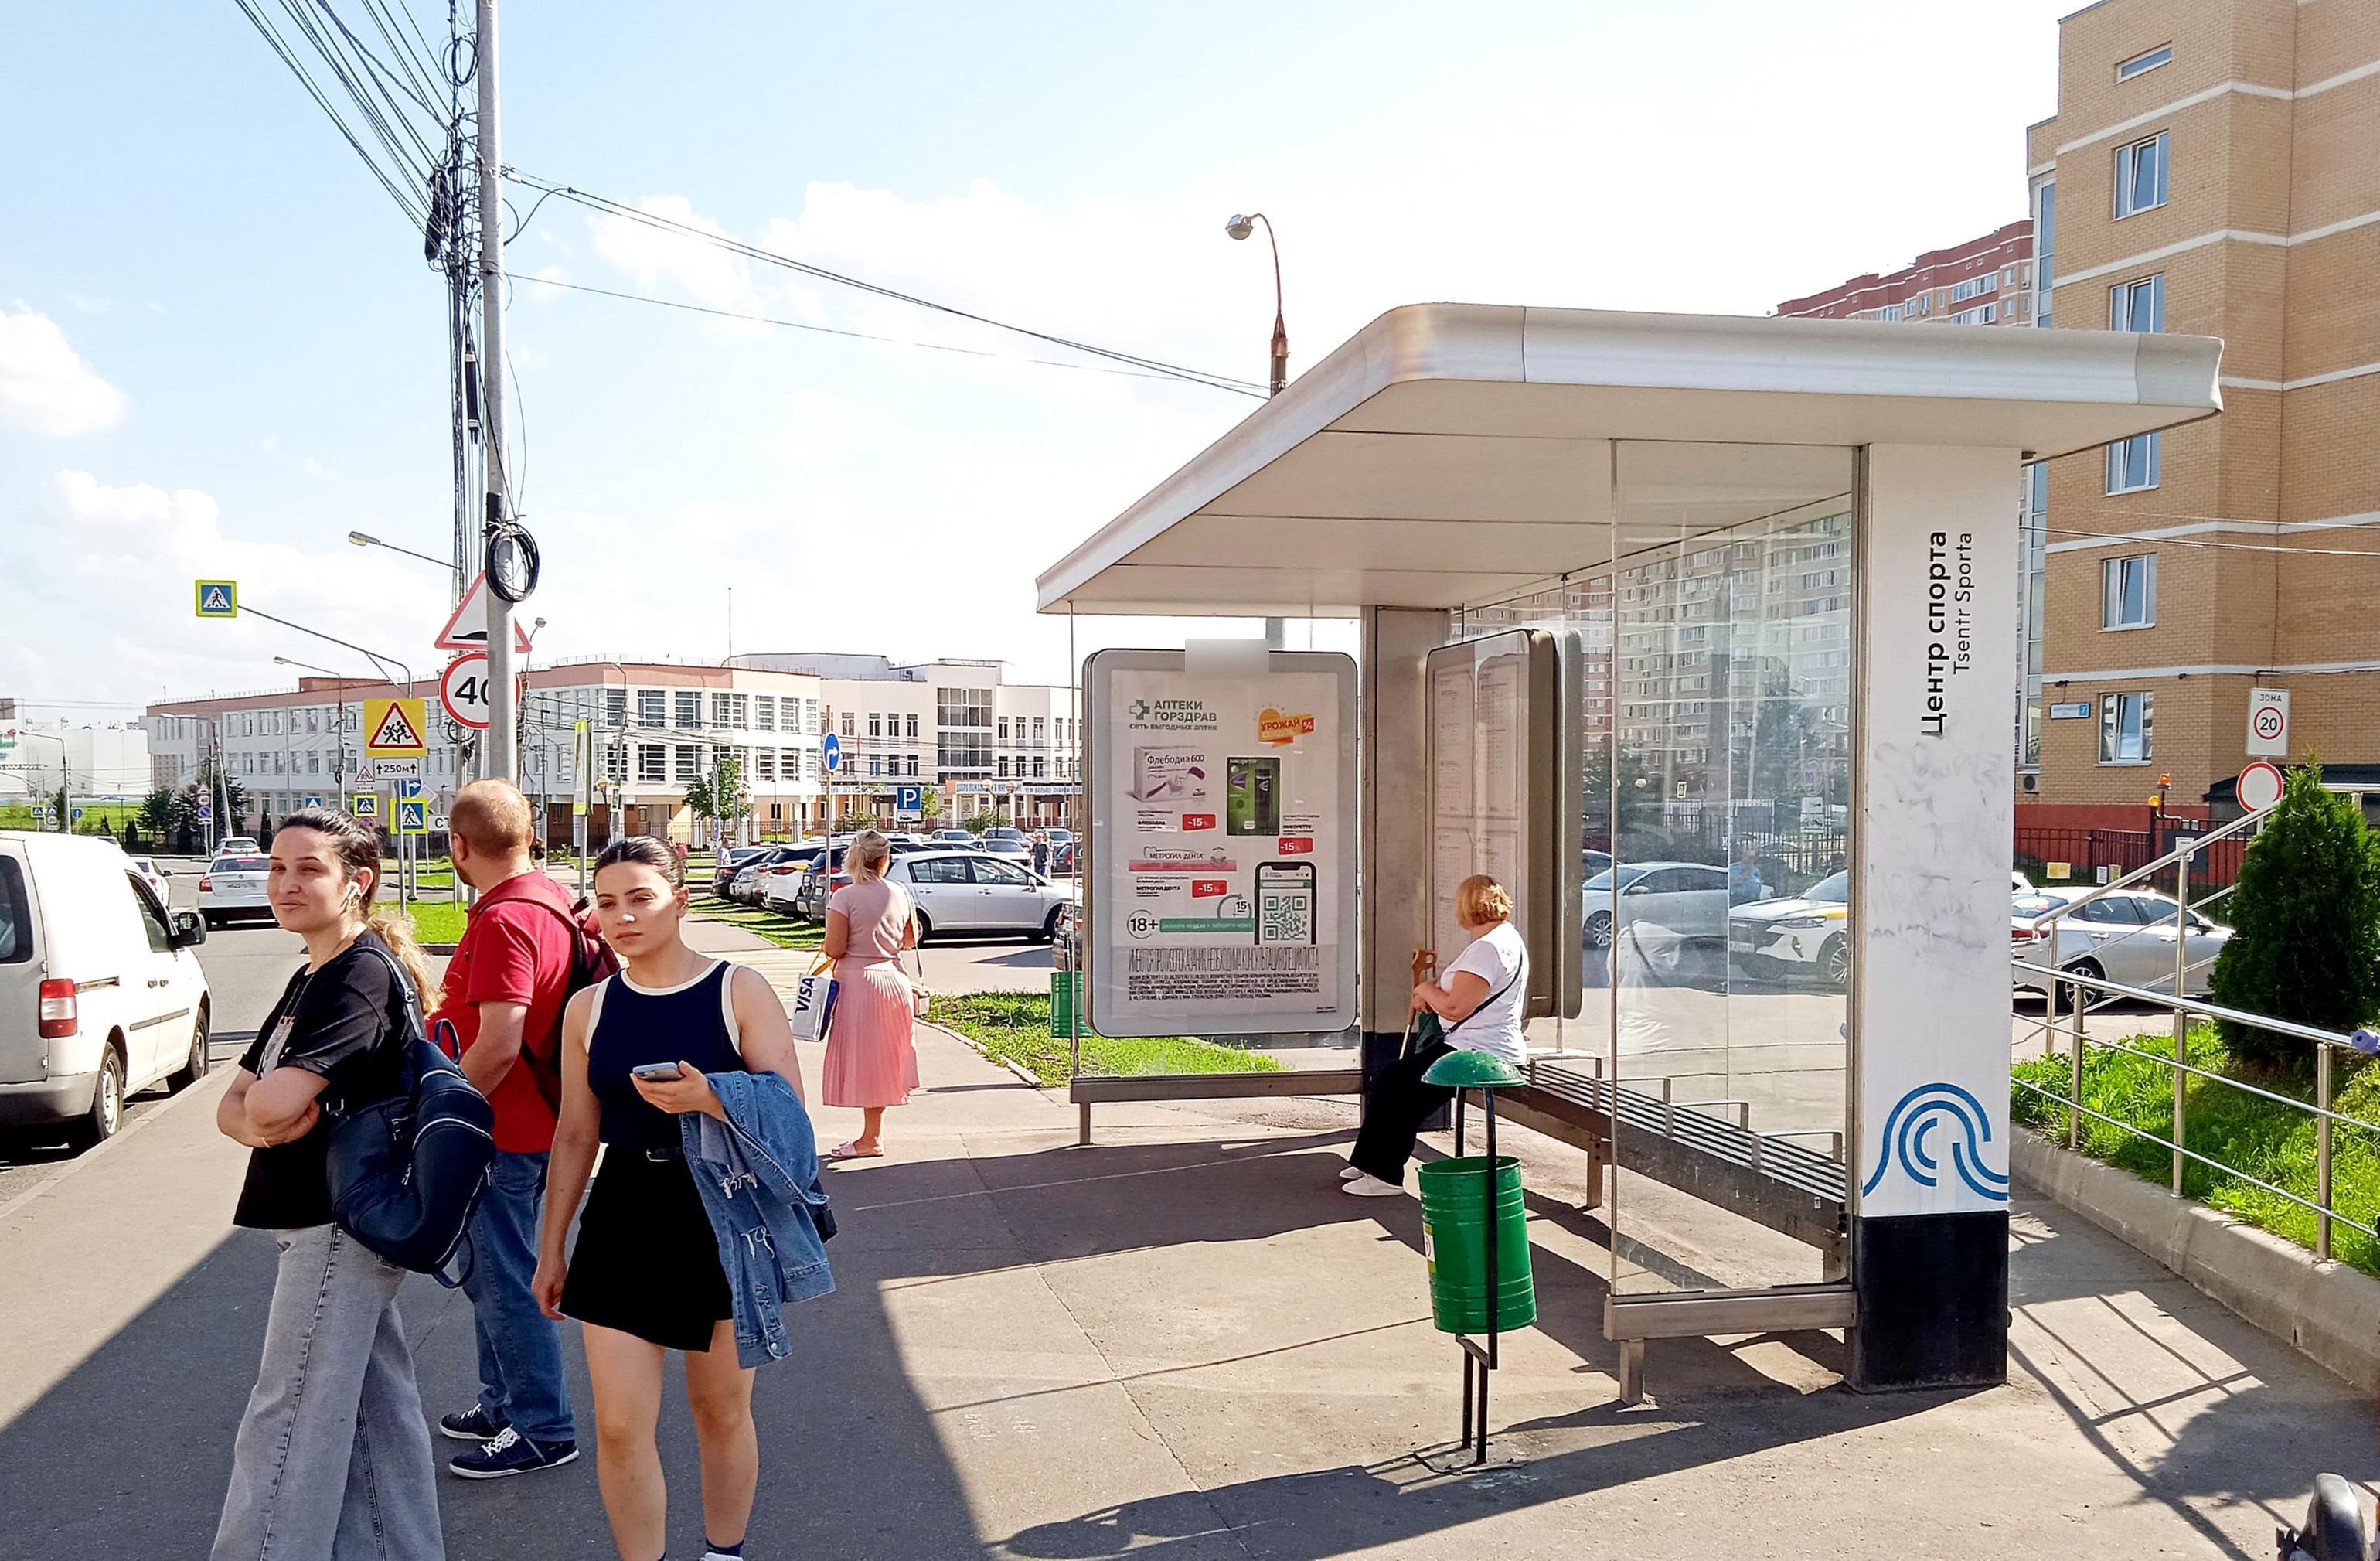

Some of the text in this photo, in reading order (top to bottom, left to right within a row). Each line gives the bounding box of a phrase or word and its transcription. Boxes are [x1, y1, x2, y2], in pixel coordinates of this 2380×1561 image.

[1953, 533, 1975, 675] Tsentr Sporta
[1921, 531, 1952, 735] Центр спорта
[1154, 700, 1203, 710] АПТЕКИ
[1154, 712, 1217, 722] ГОРЗДРАВ
[1260, 717, 1301, 731] УРОЖАЙ
[2259, 717, 2278, 731] 20
[1147, 755, 1205, 765] Флебодиа 600
[384, 765, 409, 773] 250м
[903, 789, 918, 809] P
[1236, 901, 1247, 910] 15
[1130, 918, 1159, 932] 18+
[795, 977, 815, 1014] VISA
